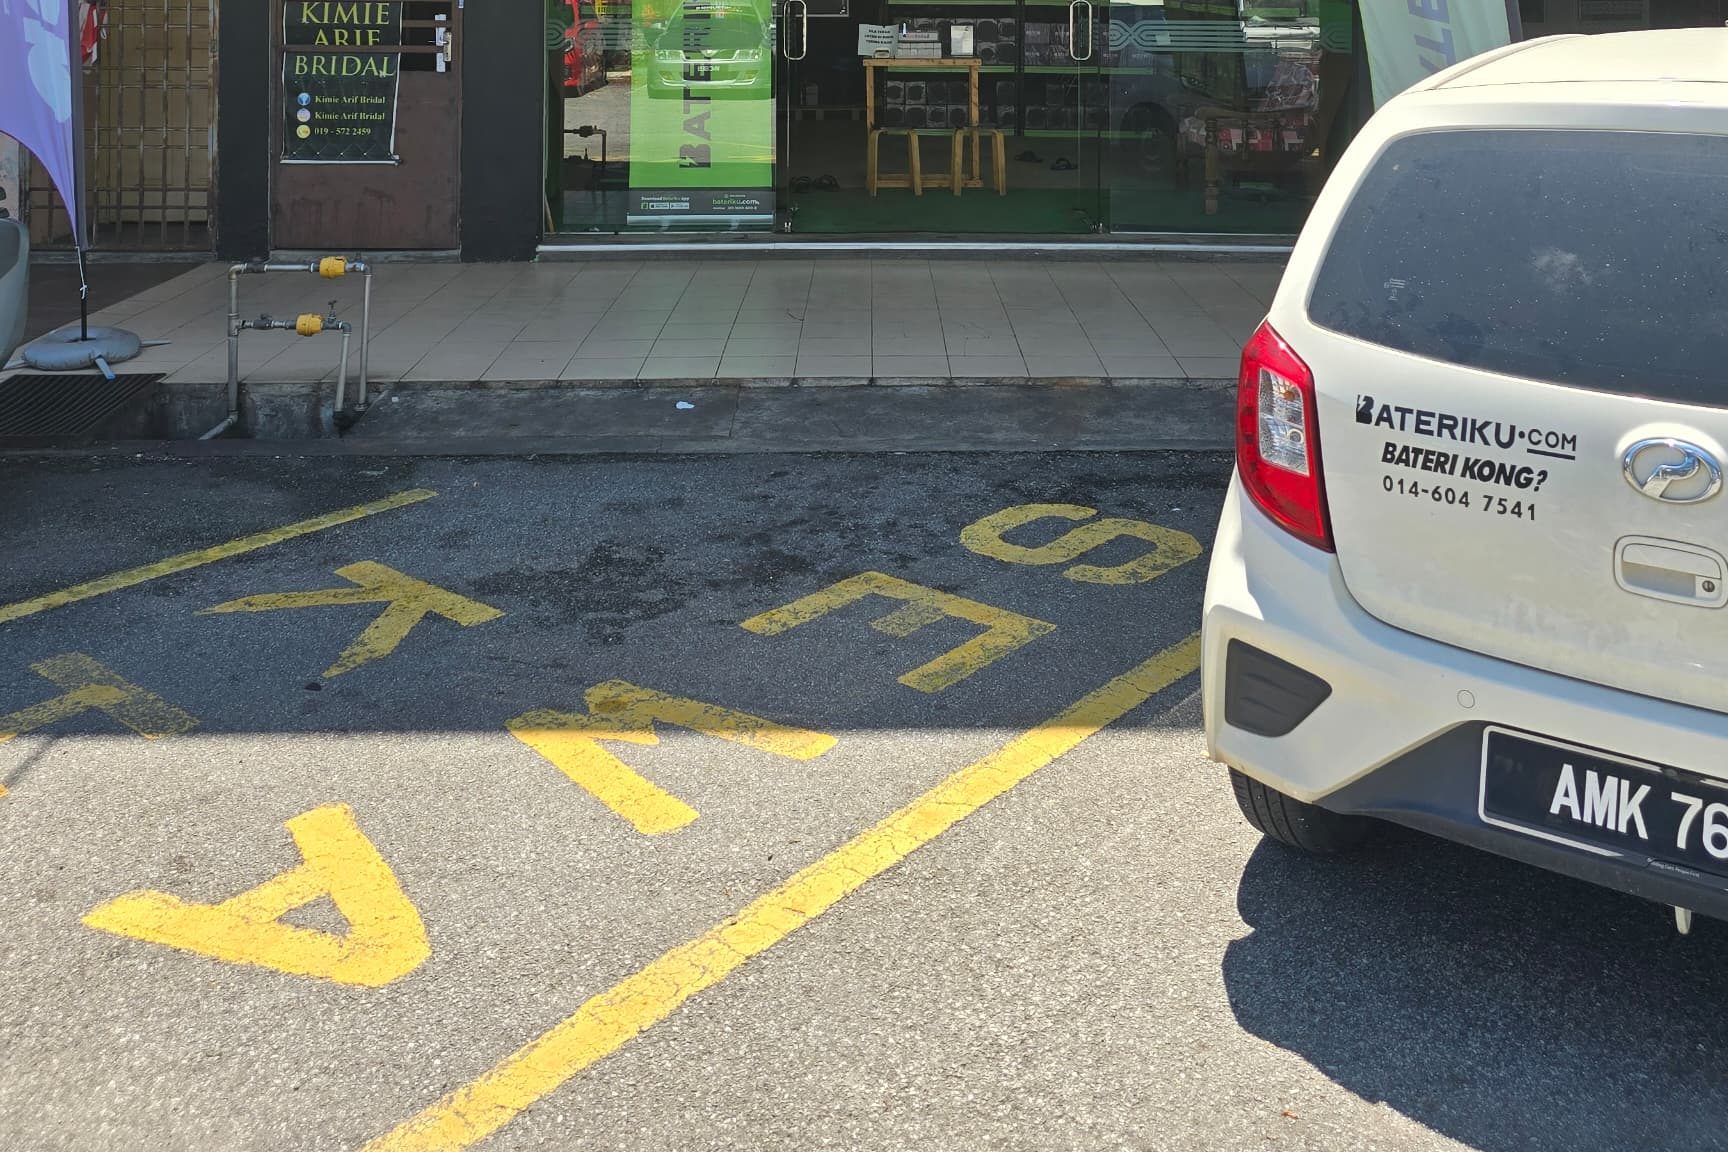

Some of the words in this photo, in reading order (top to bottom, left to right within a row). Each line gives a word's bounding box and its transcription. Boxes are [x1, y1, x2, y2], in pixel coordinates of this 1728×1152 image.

[301, 1, 390, 25] KIMIE
[314, 28, 381, 46] ARIF
[294, 54, 397, 78] BRIDAL
[314, 95, 339, 104] Kimie
[340, 95, 358, 104] Arif
[360, 95, 386, 105] Bridal
[314, 111, 339, 120] Kimie
[340, 111, 358, 120] Arif
[360, 111, 386, 121] Bridal
[314, 127, 329, 136] 019
[336, 127, 351, 136] 572
[1381, 441, 1459, 476] BATERI
[1460, 456, 1549, 492] KONG?
[1383, 475, 1470, 508] 014-604
[1482, 494, 1536, 521] 7541
[1549, 763, 1652, 840] AMK
[1670, 791, 1728, 859] 76
